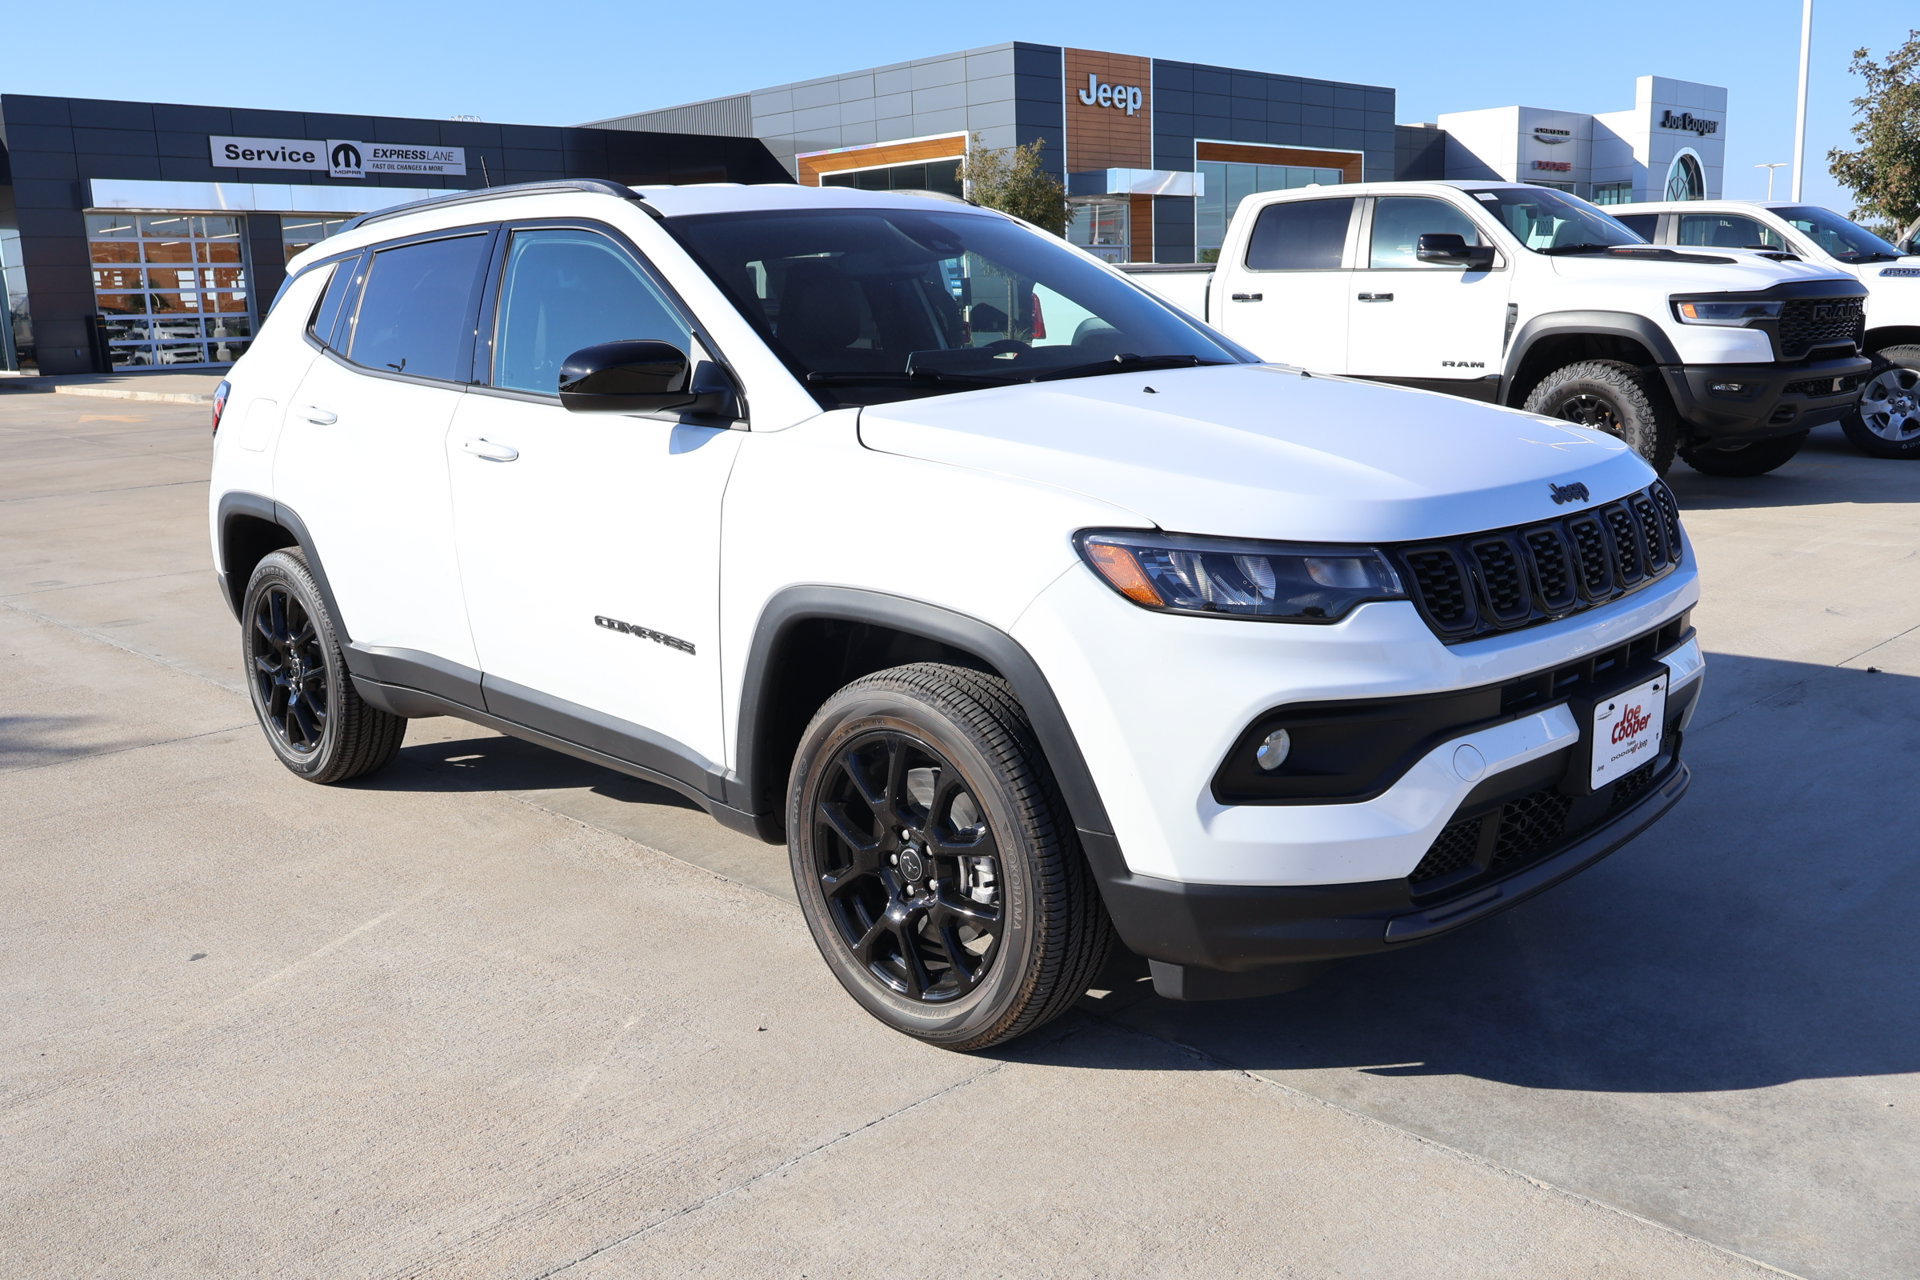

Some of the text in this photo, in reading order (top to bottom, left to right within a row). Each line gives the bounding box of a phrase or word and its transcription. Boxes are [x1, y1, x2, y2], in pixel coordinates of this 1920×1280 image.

[1079, 73, 1143, 116] Jeep
[1659, 110, 1719, 136] Joe Cooper
[225, 143, 316, 163] Service
[373, 148, 454, 161] EXPRESSLANE
[1442, 360, 1485, 368] RAM
[1550, 482, 1590, 505] Jeep
[594, 615, 696, 656] COMPASS
[1620, 703, 1642, 727] Joe
[1611, 713, 1652, 745] Cooper
[1006, 842, 1022, 929] YOKOHAMA
